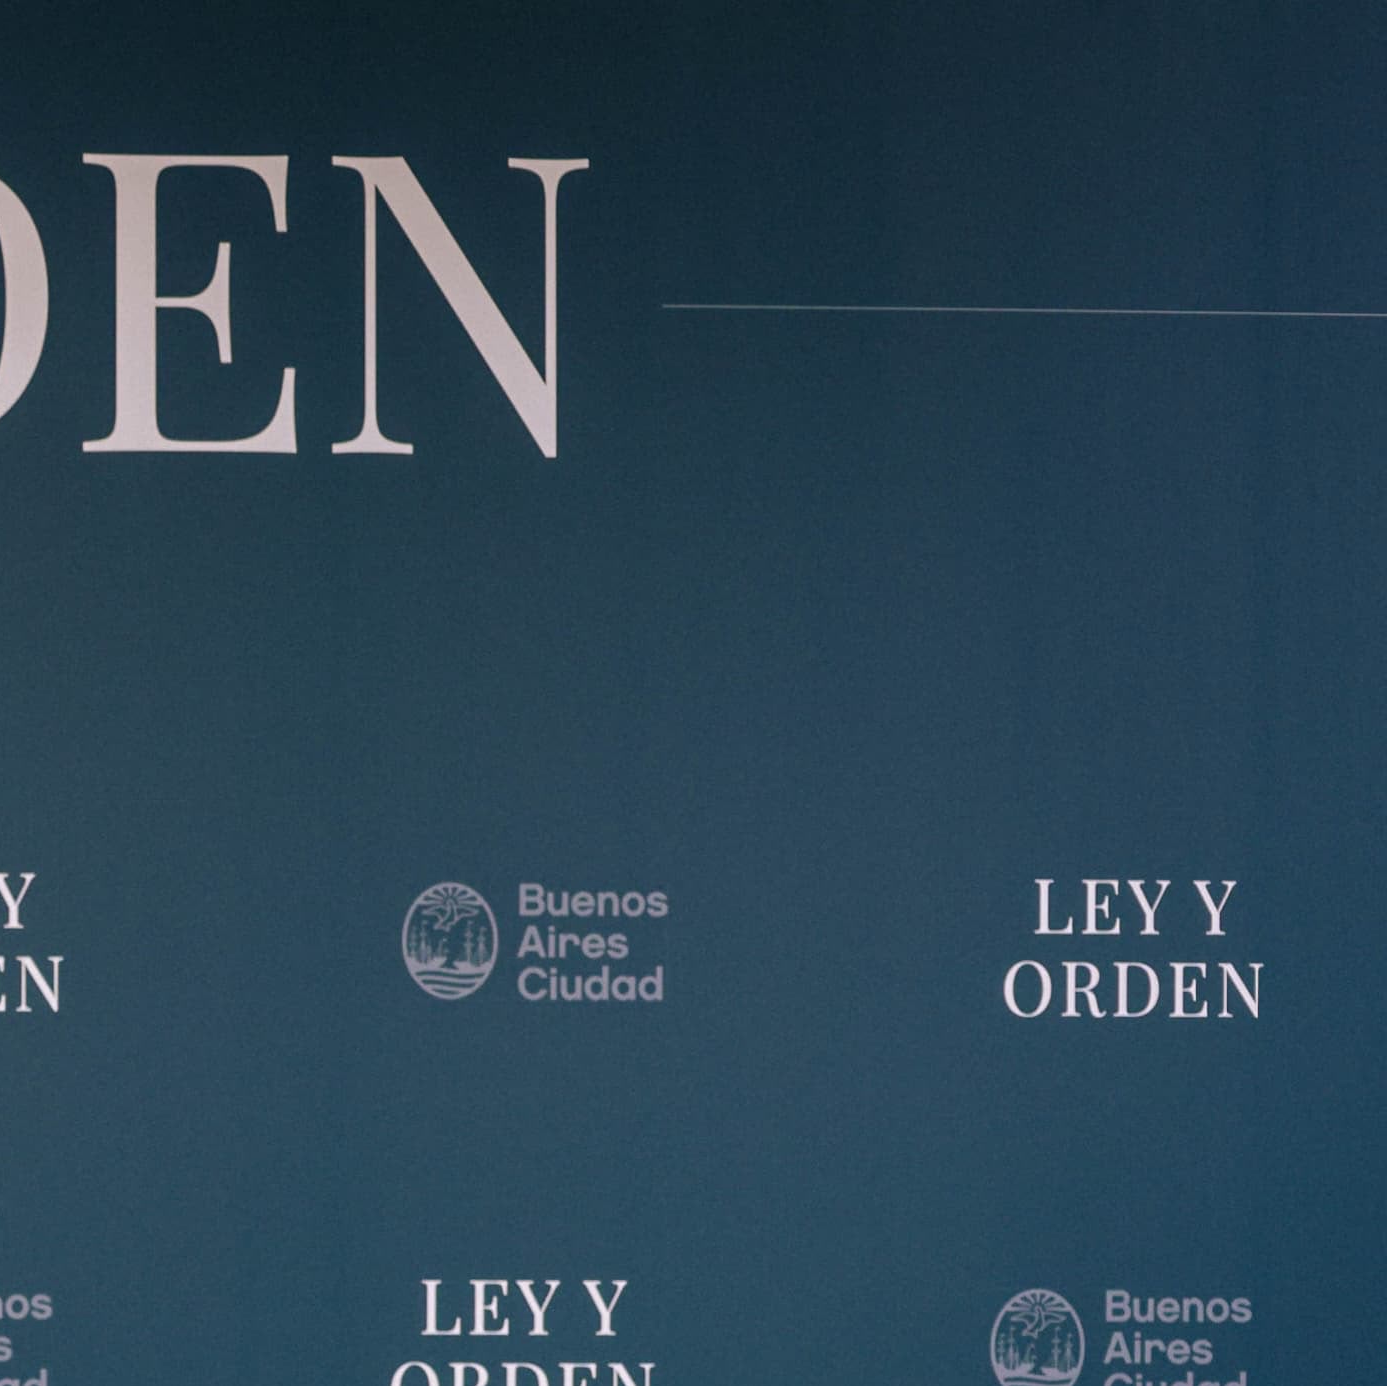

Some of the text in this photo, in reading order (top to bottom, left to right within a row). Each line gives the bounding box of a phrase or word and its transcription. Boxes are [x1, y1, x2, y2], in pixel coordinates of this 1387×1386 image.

[518, 882, 669, 918] Buenos
[1033, 878, 1237, 936] LEY Y
[517, 925, 629, 958] Aires
[517, 965, 664, 1002] Ciudad
[1002, 959, 1264, 1019] ORDEN
[420, 1278, 628, 1337] LEY Y
[1105, 1289, 1252, 1323] Buenos
[1103, 1331, 1213, 1365] Aires
